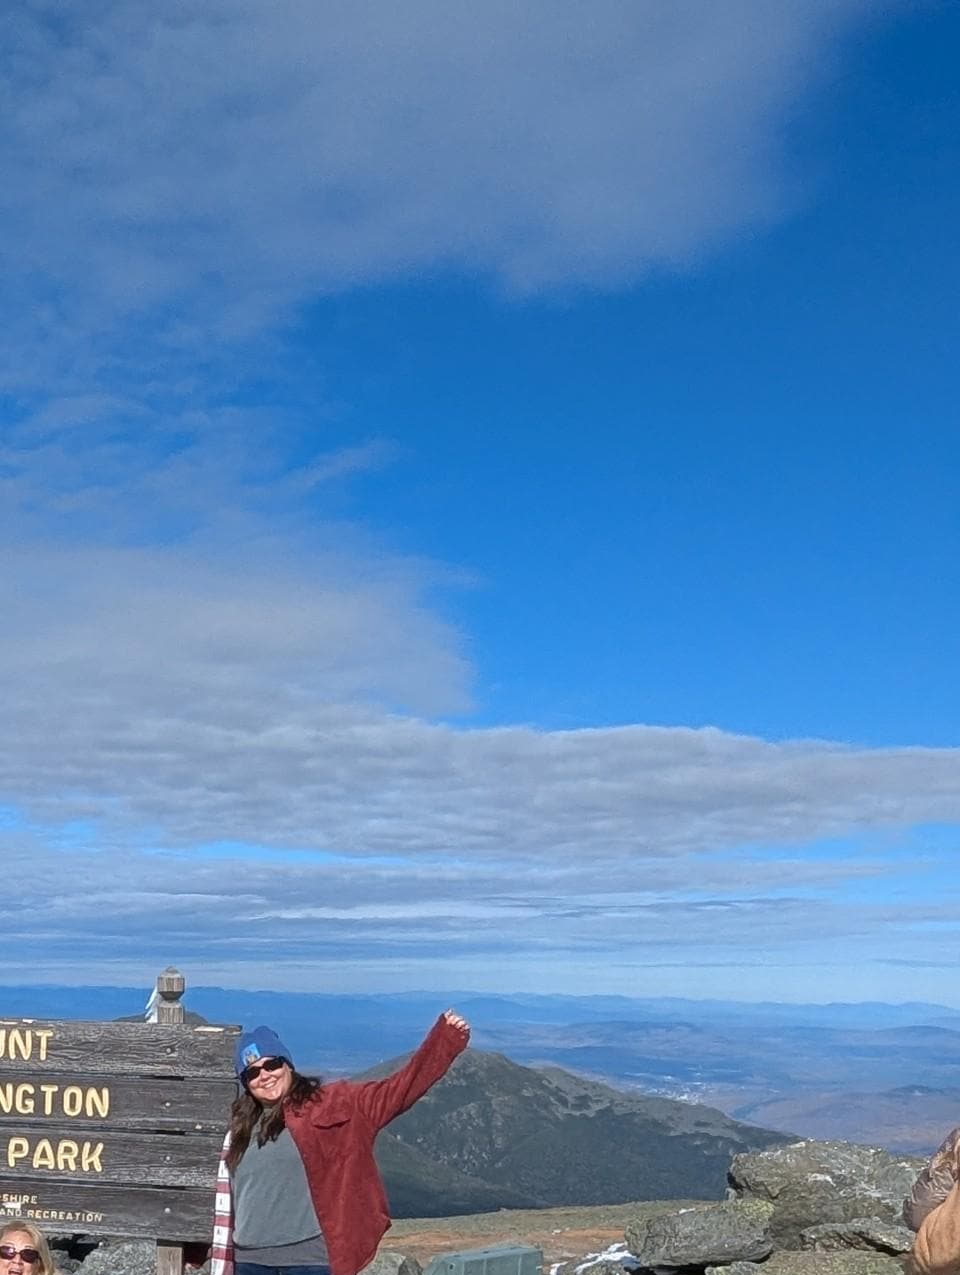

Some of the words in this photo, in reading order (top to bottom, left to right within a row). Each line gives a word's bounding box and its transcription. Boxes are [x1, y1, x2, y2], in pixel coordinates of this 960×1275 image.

[7, 1136, 104, 1172] PARK
[0, 1207, 22, 1217] AND
[27, 1209, 103, 1222] RECREATION
